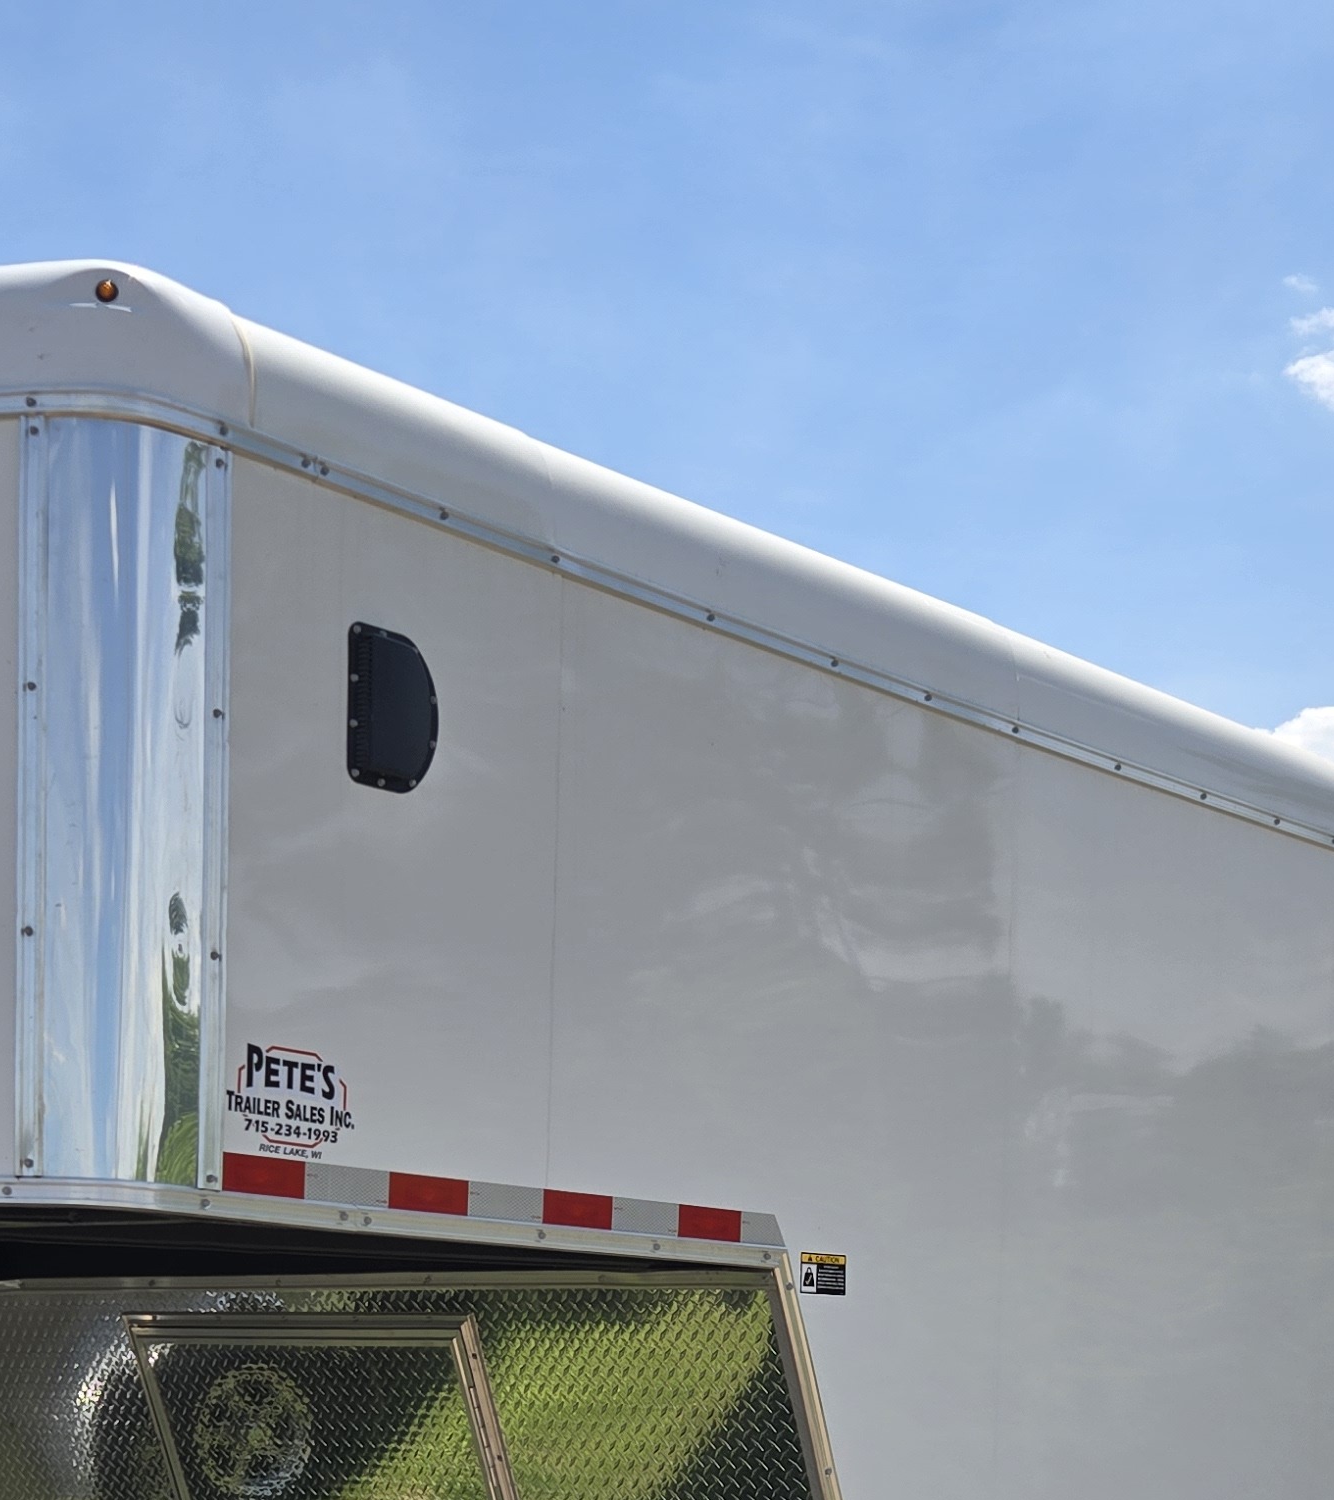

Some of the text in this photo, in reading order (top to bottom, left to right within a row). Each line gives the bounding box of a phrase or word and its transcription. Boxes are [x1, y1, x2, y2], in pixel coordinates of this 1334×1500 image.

[245, 1042, 336, 1101] PETE'S
[226, 1089, 355, 1130] TRAILER SALES INC.
[244, 1117, 339, 1144] 715-234-1993
[258, 1143, 282, 1155] RICE
[310, 1150, 323, 1160] WI
[815, 1255, 840, 1264] CAUTION
